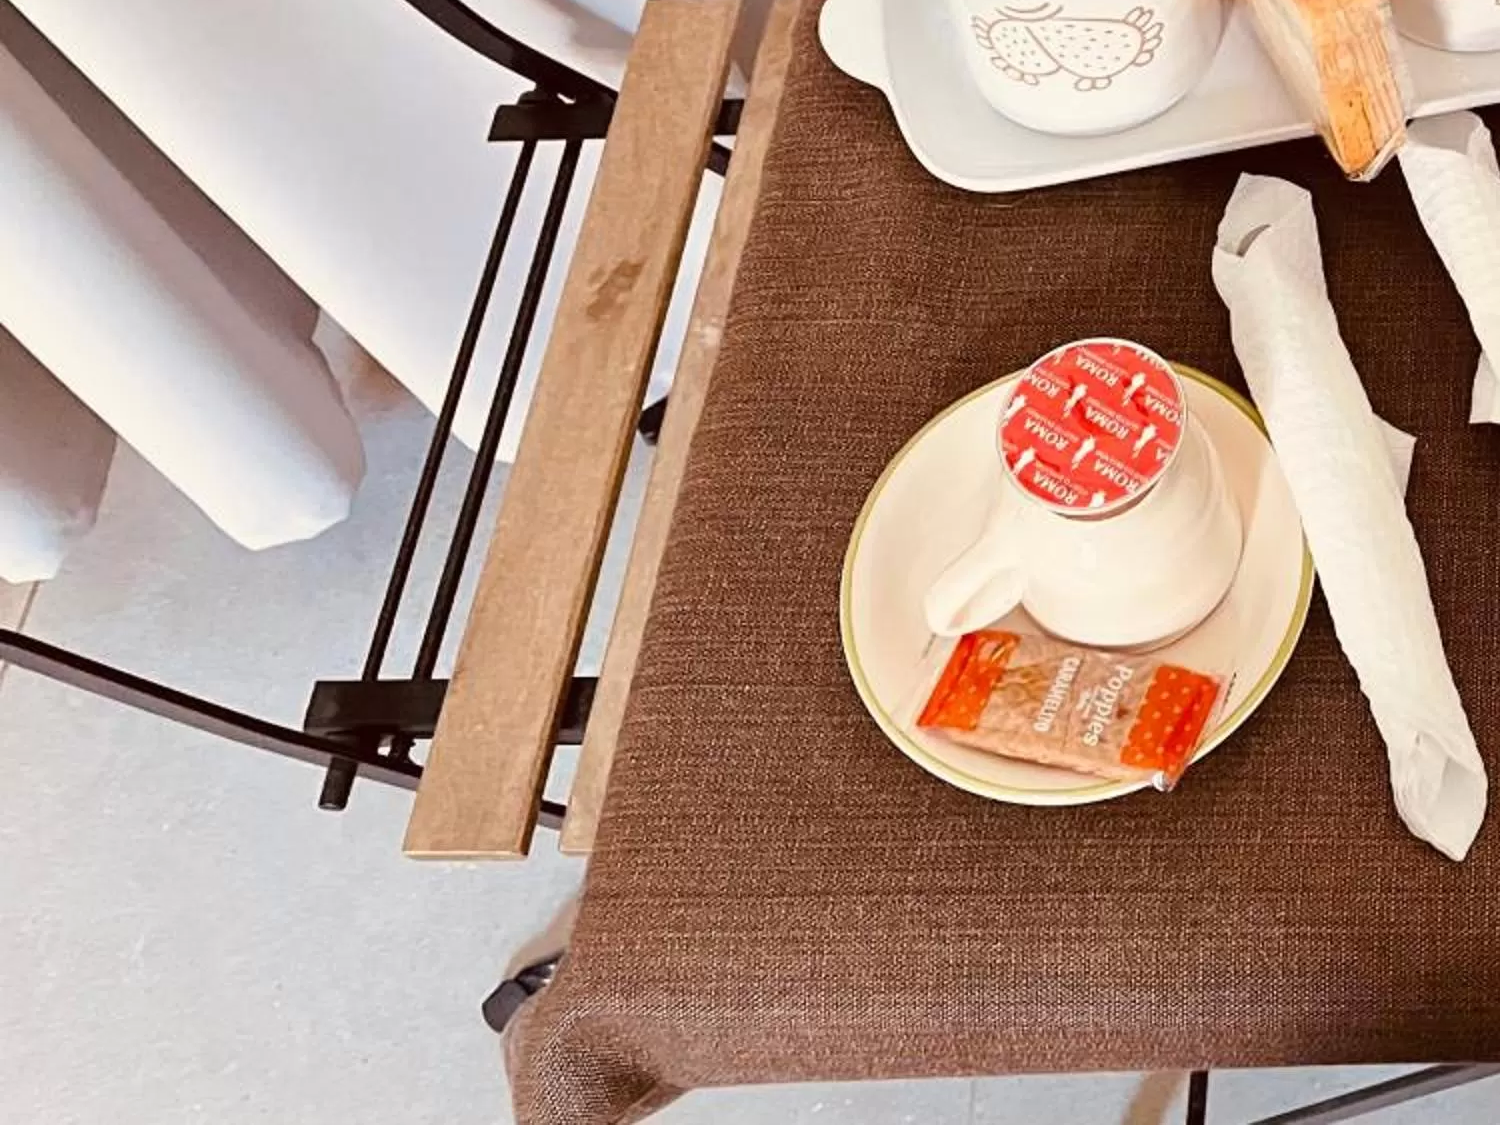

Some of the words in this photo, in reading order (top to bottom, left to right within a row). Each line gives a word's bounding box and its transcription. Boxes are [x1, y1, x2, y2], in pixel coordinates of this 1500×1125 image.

[1075, 354, 1119, 387] ROMA
[1023, 417, 1070, 451] ROMA
[1085, 405, 1130, 440] ROMA
[1032, 470, 1079, 505] ROMA
[1093, 457, 1142, 493] ROMA
[1083, 664, 1134, 746] Poppies
